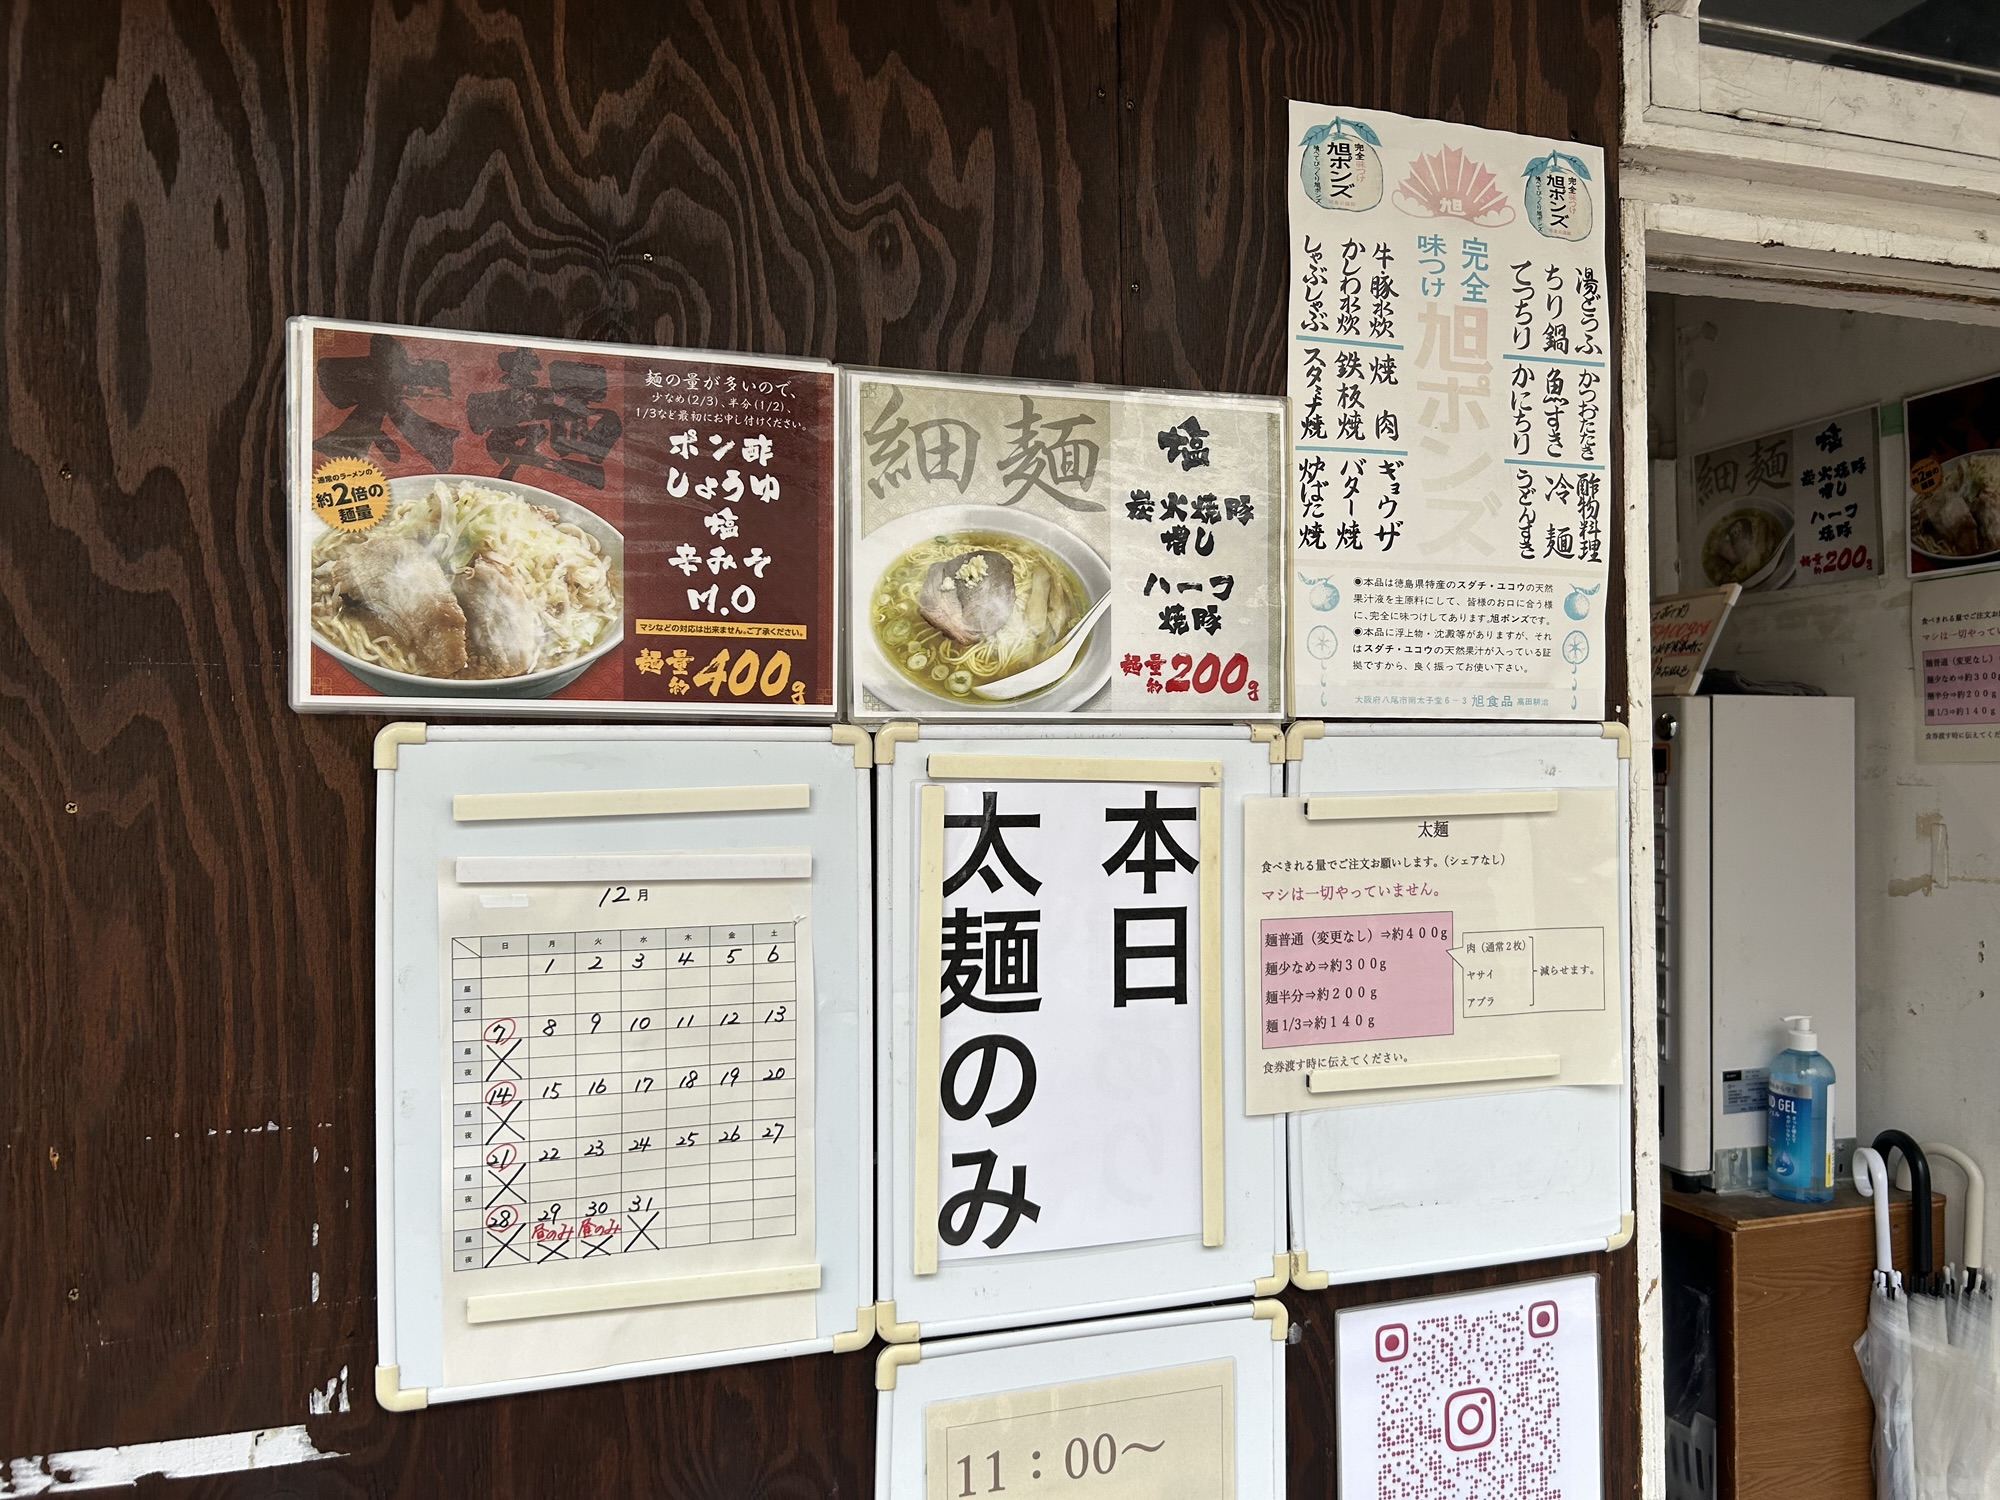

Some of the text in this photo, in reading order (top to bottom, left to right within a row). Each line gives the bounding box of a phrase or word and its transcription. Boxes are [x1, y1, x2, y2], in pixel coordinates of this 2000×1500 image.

[1327, 142, 1355, 199] 旭ポンズ
[1354, 143, 1366, 183] 完全味つけ
[1439, 197, 1463, 216] 旭
[1547, 174, 1570, 229] 旭ポンズ
[1568, 177, 1577, 214] 完全味つけ
[1300, 234, 1329, 332] しゃぶしゃぶ
[1417, 233, 1447, 297] 味つけ
[1460, 237, 1490, 304] 完全
[1336, 237, 1366, 335] かしわ水炊
[1510, 260, 1535, 350] てっちり
[1542, 263, 1569, 355] ちり鍋
[1574, 266, 1602, 355] 湯どうふ
[645, 369, 796, 399] 麺の量が多いので、
[1300, 348, 1328, 440] スタミナ焼
[1334, 350, 1366, 441] 鉄板焼
[1369, 353, 1399, 442] 焼肉
[313, 332, 622, 490] 太麺
[636, 408, 807, 430] 1/3など最初にお申し付けください。
[1511, 363, 1535, 455] かにちり
[1543, 367, 1569, 458] 魚すき
[1578, 368, 1600, 461] かつおたたき
[669, 429, 774, 466] ポン酢
[863, 384, 1106, 512] 細麺
[1158, 415, 1210, 472] 塩
[1413, 302, 1503, 557] 旭ポンズ
[317, 469, 373, 484] 通常のラーメンの
[666, 466, 780, 503] しょうゆ
[1697, 438, 1793, 506] 細麺
[316, 482, 384, 508] 約2倍の
[338, 504, 374, 524] 麺量
[1125, 489, 1254, 526] 炭火焼豚
[1298, 456, 1328, 550] 炉ばた焼
[1335, 458, 1366, 550] バター焼
[1374, 460, 1404, 552] ギョウザ
[1516, 468, 1536, 560] うどんすき
[704, 507, 739, 540] 塩
[1544, 472, 1575, 559] 冷麺
[1576, 472, 1602, 563] 酢物料理
[1160, 524, 1215, 556] 増し
[668, 543, 772, 578] 辛みそ
[687, 583, 756, 616] M.O
[1143, 573, 1234, 601] ハーフ
[639, 623, 804, 637] マシなどの対応は出来ません。ご了承ください。
[1158, 603, 1221, 636] 焼豚
[693, 648, 806, 705] 400g
[1165, 652, 1259, 702] 200g
[1472, 695, 1513, 708] 旭食品
[1418, 821, 1449, 838] 太麺
[1102, 790, 1200, 1007] 本日
[1261, 882, 1440, 901] マシは一切やっていません。
[502, 929, 778, 950] 日 月 火 水 木 金 土
[545, 944, 779, 973] 1 2 3 4 5 6
[1466, 970, 1493, 980] ヤサイ
[1540, 964, 1594, 976] 減らせます。
[938, 791, 1042, 1249] 太麺のみ
[1467, 997, 1494, 1008] アブラ
[493, 1005, 787, 1044] 7 8 9 10 11 12 13
[1263, 1052, 1408, 1074] 食券渡す時に伝えてください。
[488, 1067, 786, 1106] 14 15 16 17 18 19 20
[1778, 1098, 1797, 1114] GEL
[486, 1123, 785, 1169] 21 22 23 24 25 26 27
[487, 1195, 653, 1228] 28 29 30 31
[531, 1217, 621, 1242] 昼のみ 昼のみ
